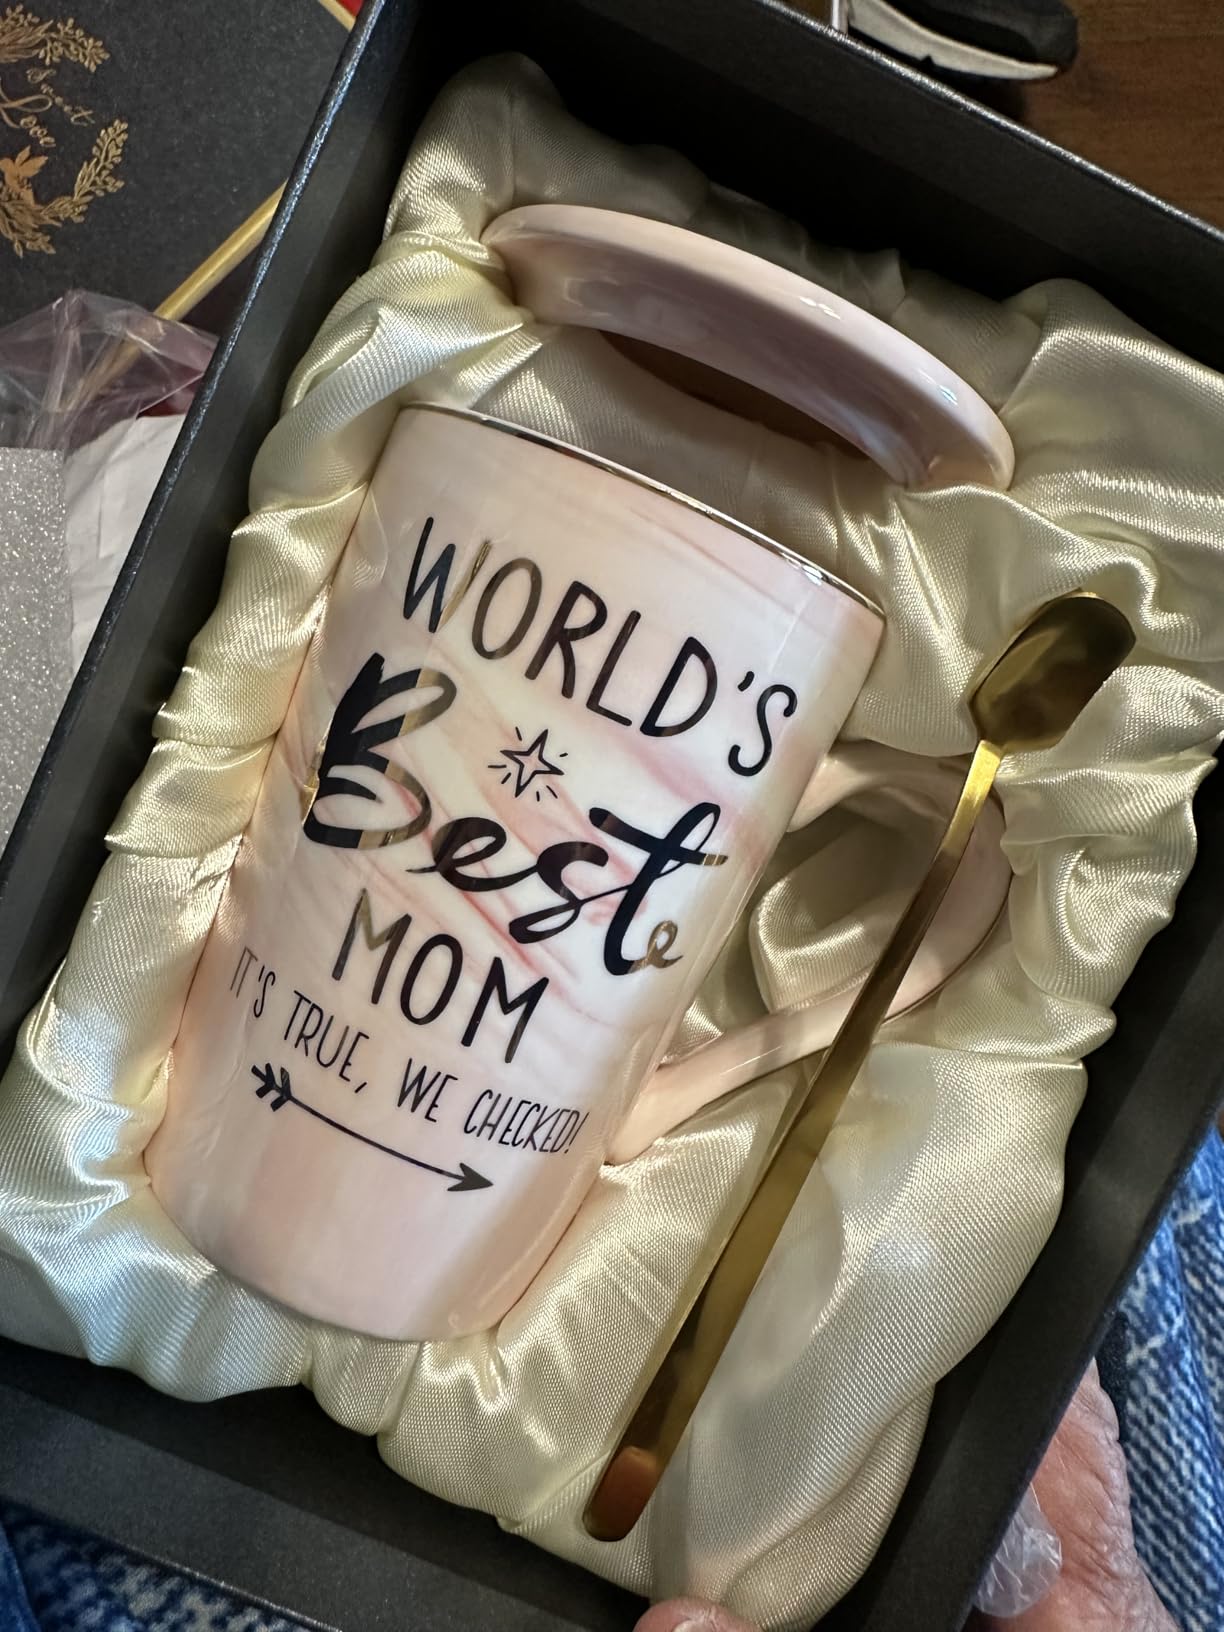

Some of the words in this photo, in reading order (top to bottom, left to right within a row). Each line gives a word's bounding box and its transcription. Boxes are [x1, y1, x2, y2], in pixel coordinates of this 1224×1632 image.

[402, 516, 799, 778] WORLD'S
[303, 652, 729, 977] Best
[229, 945, 276, 1020] IT'S
[283, 989, 370, 1095] TRUE,
[396, 1057, 459, 1124] WE
[463, 1088, 590, 1155] CHECKED!
[331, 887, 550, 1064] MOM
